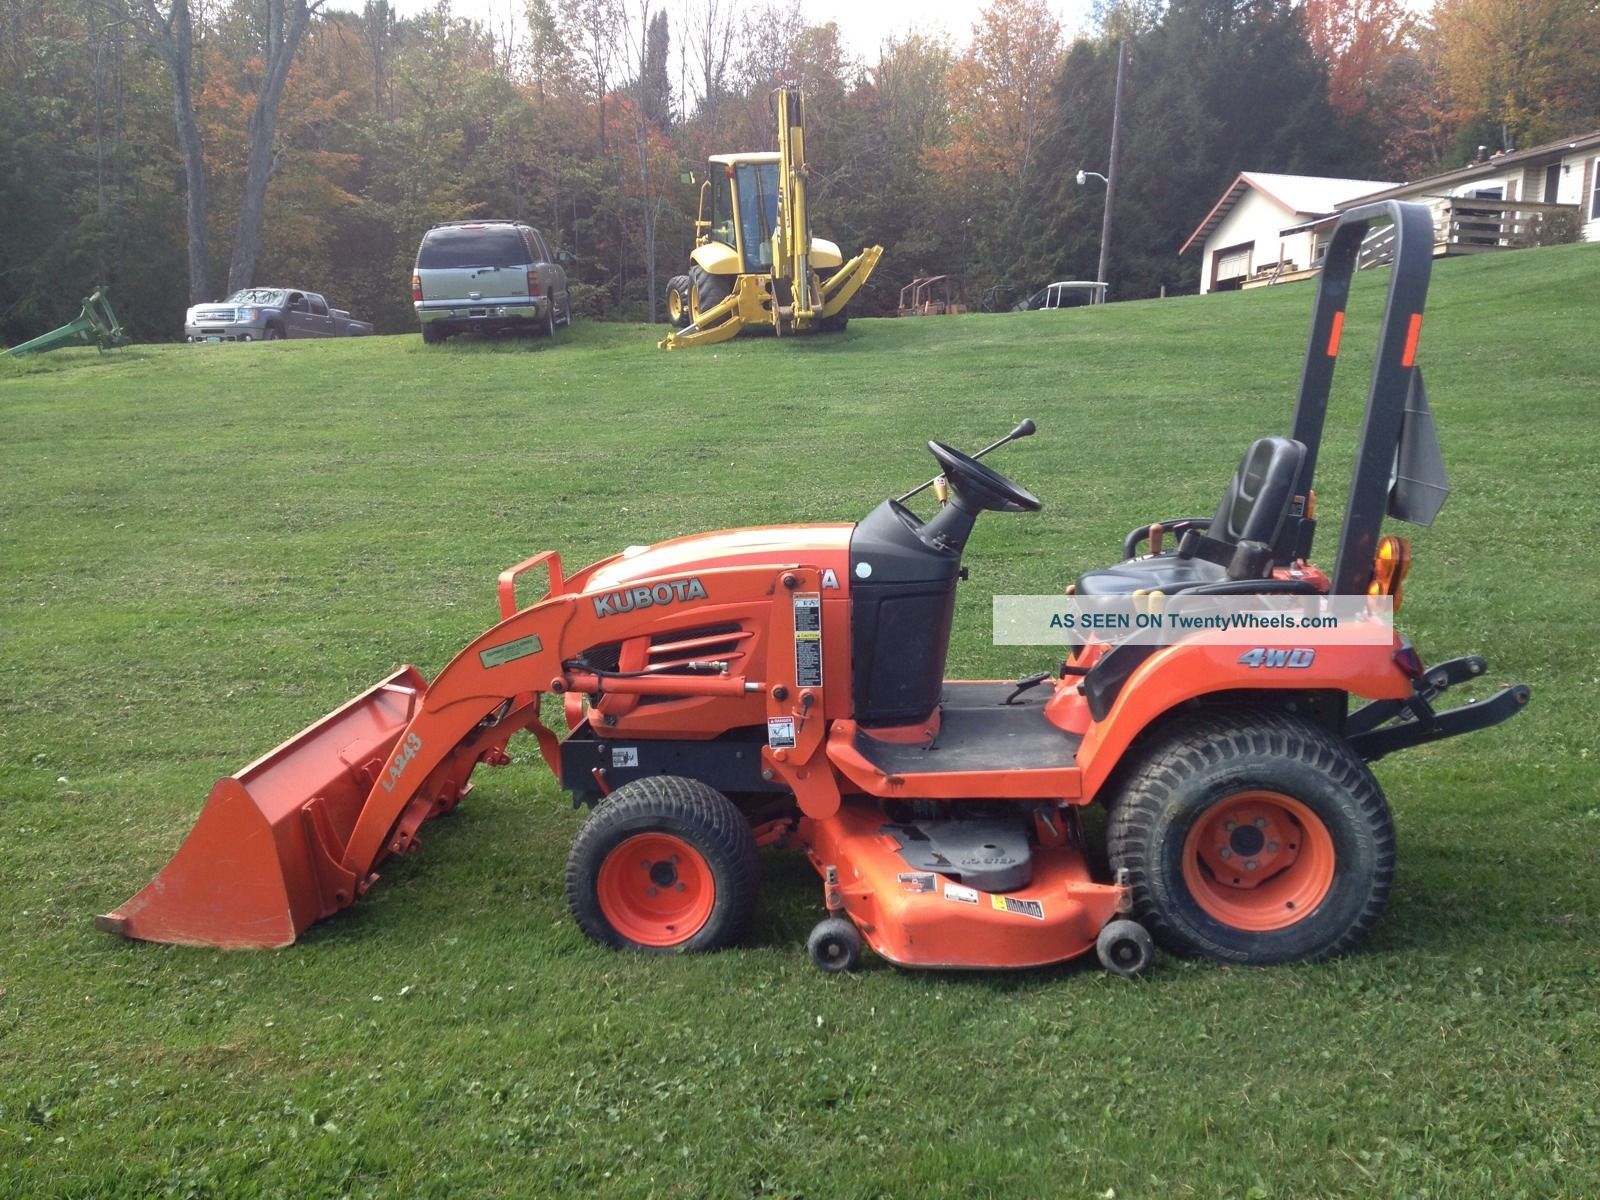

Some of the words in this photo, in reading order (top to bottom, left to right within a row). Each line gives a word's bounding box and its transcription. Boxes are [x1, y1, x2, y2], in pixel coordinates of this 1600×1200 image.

[594, 577, 708, 617] KUBOTA
[1238, 648, 1316, 669] 4WD
[382, 733, 422, 792] LA243
